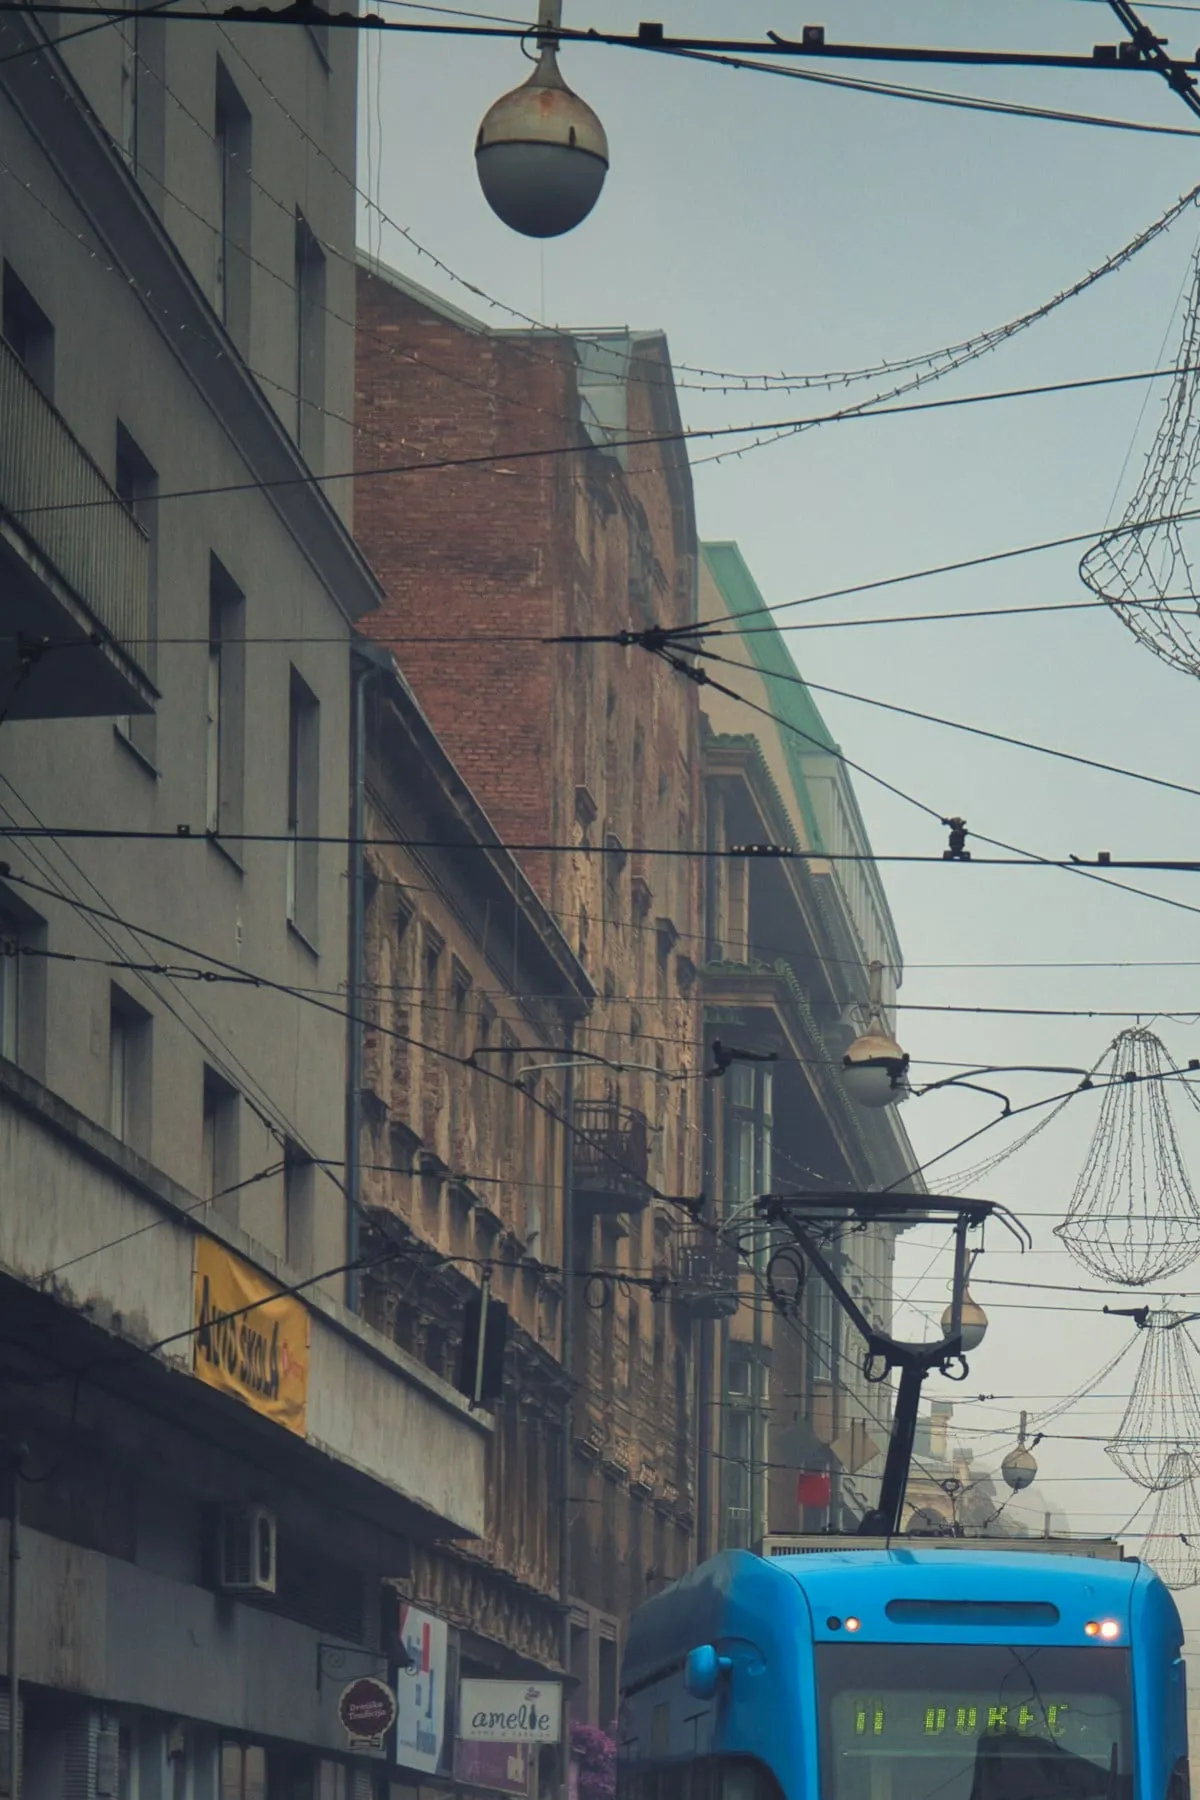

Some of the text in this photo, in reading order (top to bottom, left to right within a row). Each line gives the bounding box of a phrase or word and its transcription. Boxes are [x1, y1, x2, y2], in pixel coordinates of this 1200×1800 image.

[199, 1274, 238, 1377] AUTO
[239, 1312, 280, 1402] ŠKOLA
[472, 1704, 550, 1731] amelie
